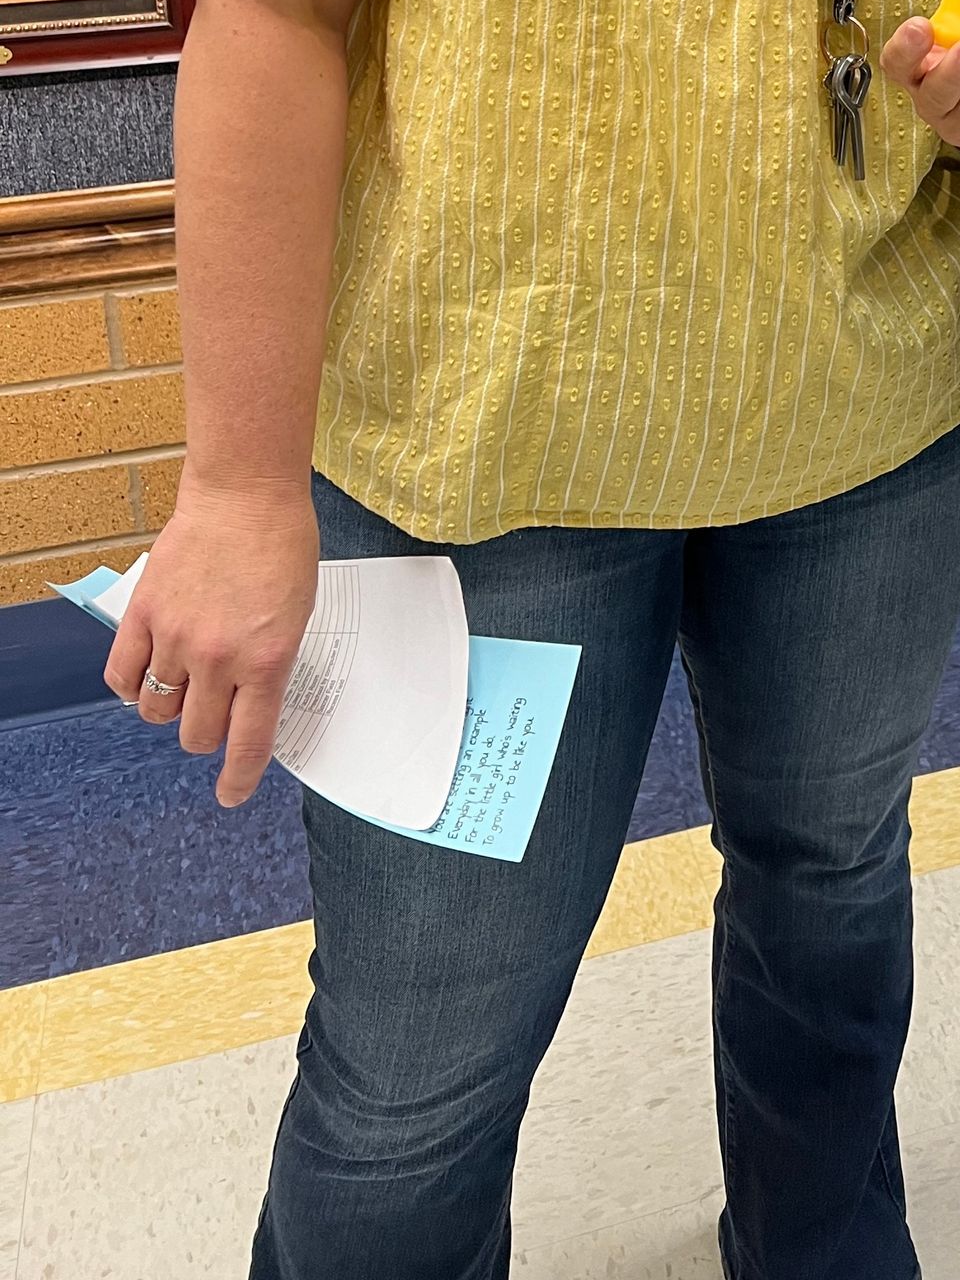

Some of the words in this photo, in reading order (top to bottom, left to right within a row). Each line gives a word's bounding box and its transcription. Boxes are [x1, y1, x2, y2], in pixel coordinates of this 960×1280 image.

[523, 716, 536, 736] you
[513, 740, 527, 755] like
[444, 800, 453, 815] are
[450, 765, 471, 797] setting
[463, 749, 473, 760] an
[470, 709, 488, 745] example
[478, 752, 491, 769] you
[509, 760, 521, 771] be
[465, 828, 478, 843] For
[474, 808, 486, 823] the
[482, 783, 496, 804] little
[491, 764, 503, 781] girl
[498, 735, 512, 760] who's
[507, 697, 527, 730] waiting
[470, 773, 482, 783] all
[506, 775, 517, 786] to
[465, 787, 477, 796] in
[502, 791, 515, 804] up
[448, 799, 474, 839] Everyday
[491, 808, 505, 833] grow
[482, 835, 494, 845] To
